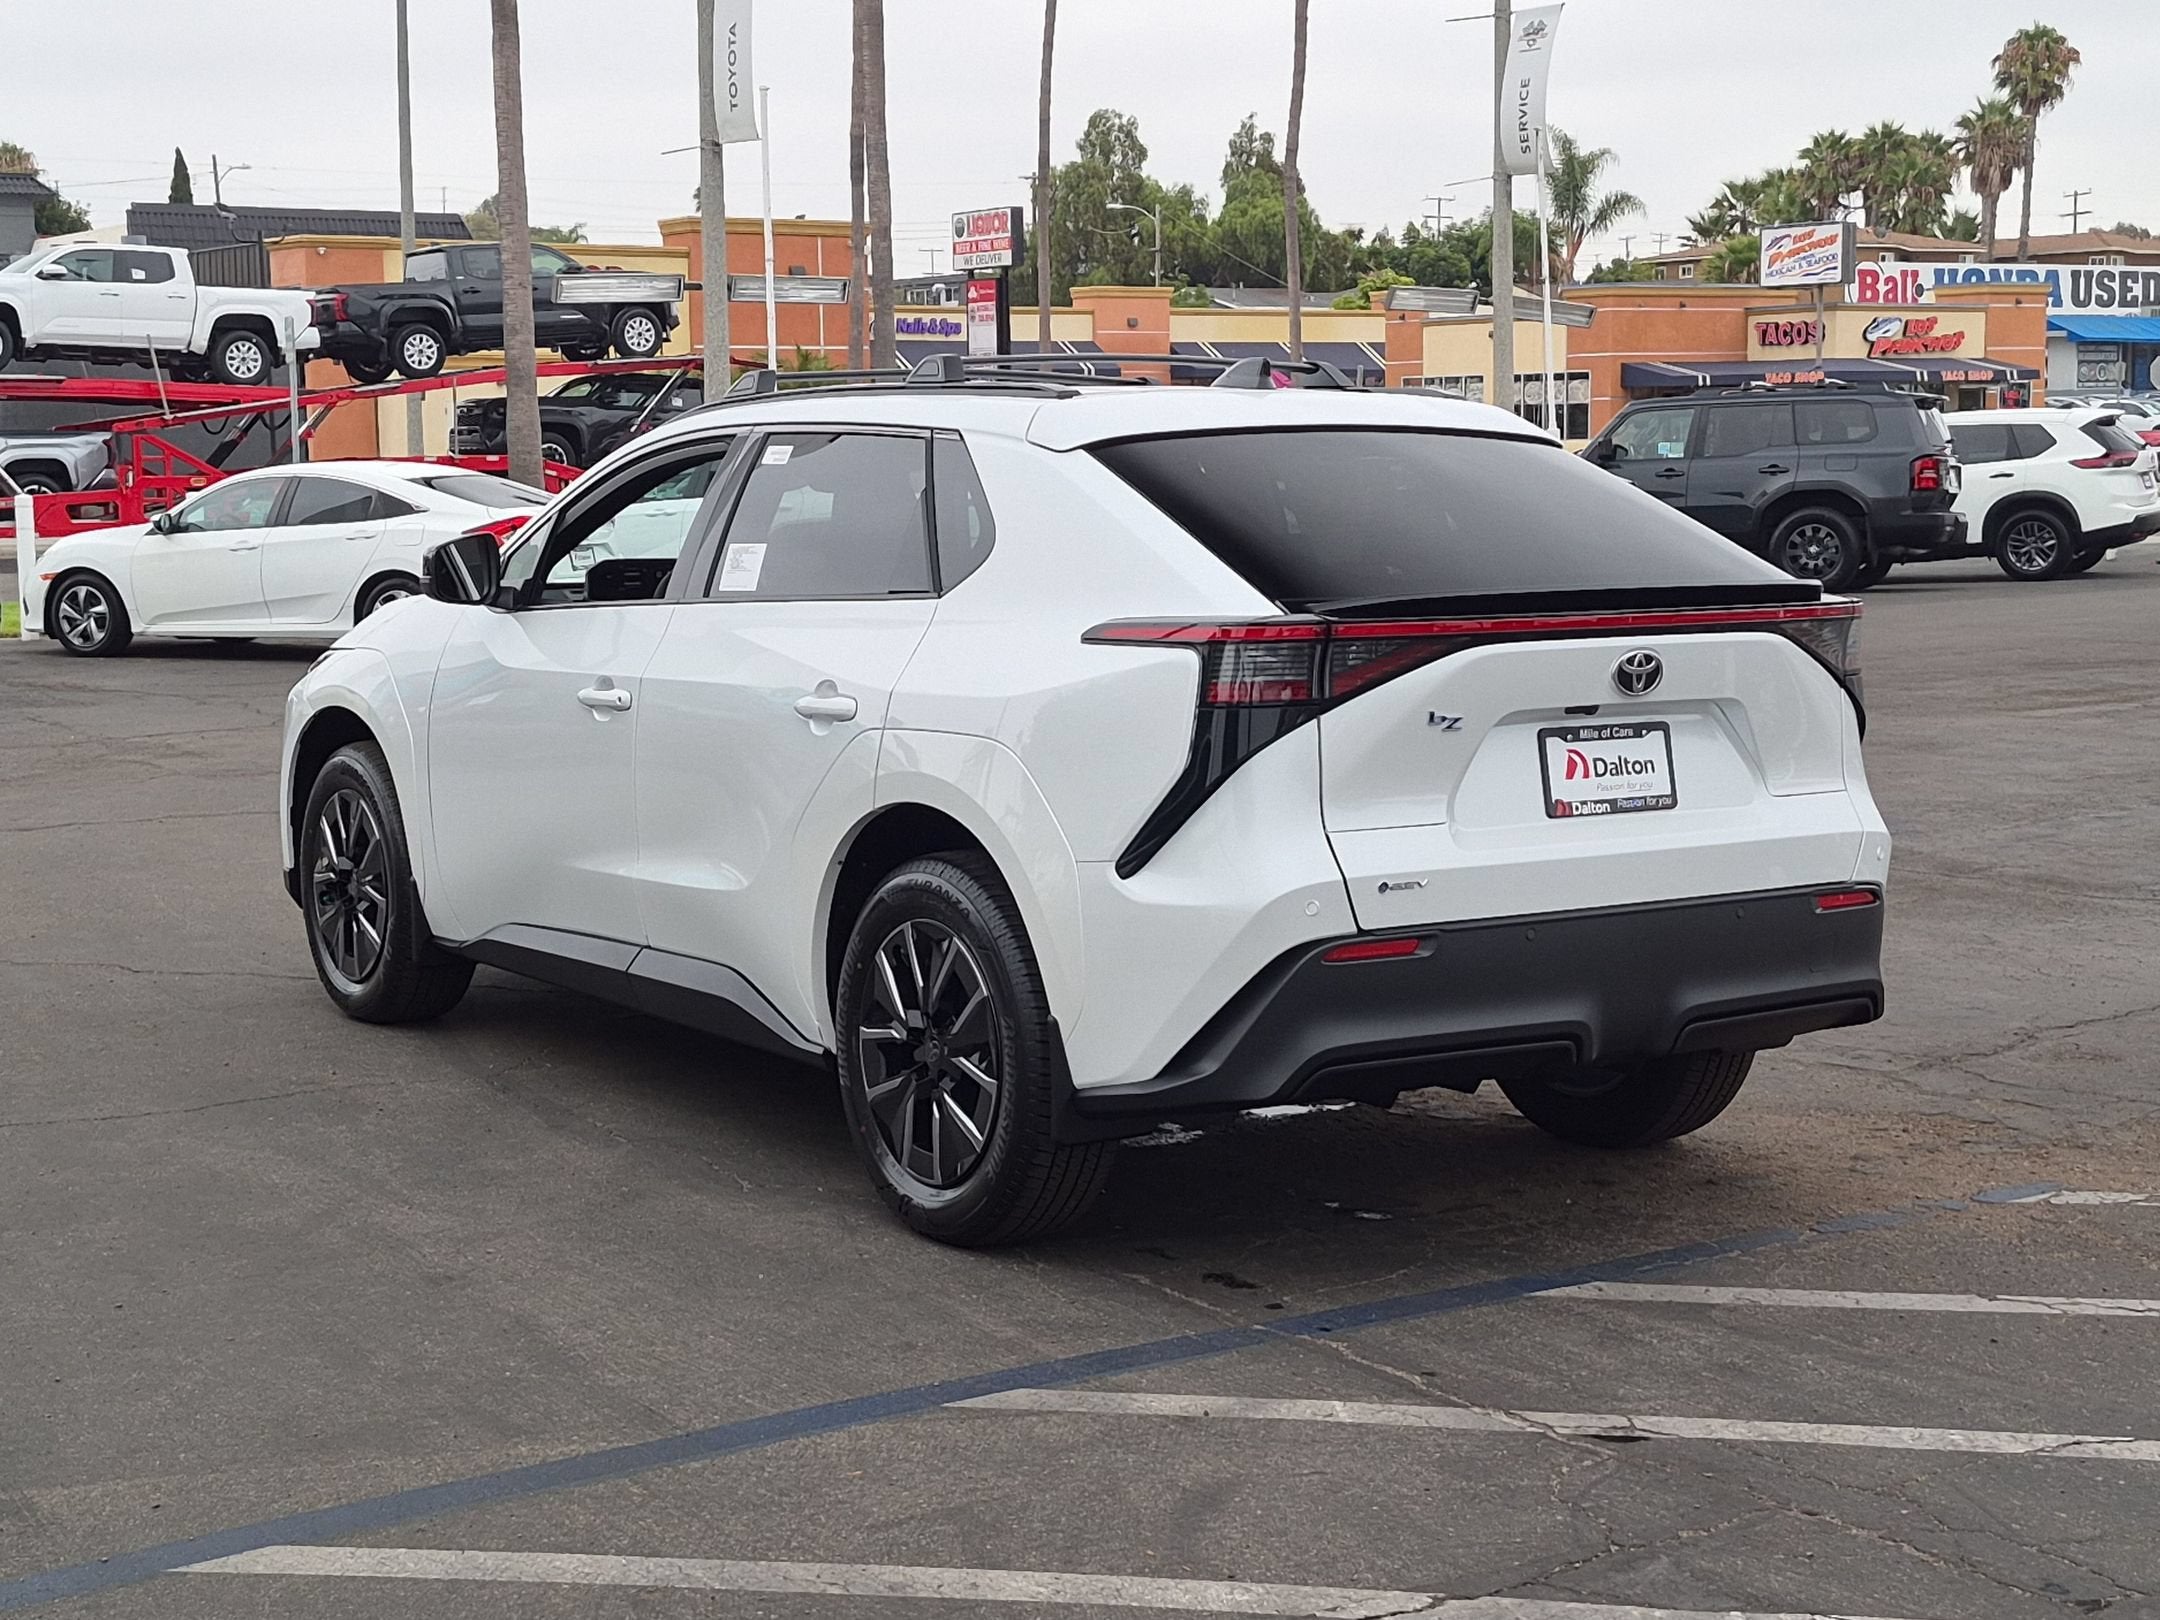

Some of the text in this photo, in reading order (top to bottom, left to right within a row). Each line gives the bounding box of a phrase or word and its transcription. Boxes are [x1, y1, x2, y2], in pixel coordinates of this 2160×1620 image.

[727, 22, 738, 113] TOYOTA
[1518, 77, 1531, 154] SERVICE
[967, 210, 1009, 237] LIQUOR
[1792, 228, 1816, 245] LOS
[963, 252, 1002, 266] WE DELIVER
[1767, 233, 1839, 270] PANCHOS
[1765, 264, 1796, 278] MEXICAN
[1804, 252, 1839, 268] SEAFOOD
[1856, 268, 1920, 304] Ball
[2070, 269, 2160, 309] USED
[896, 317, 928, 335] Nails
[928, 318, 938, 335] &
[938, 317, 962, 338] Spa
[1754, 320, 1825, 347] TACOS
[1904, 316, 1938, 337] LOS
[1870, 330, 1965, 358] PANCHOS
[1764, 371, 1825, 385] TACO SHOP
[1940, 370, 1994, 381] TACO SHOP
[1579, 727, 1634, 739] Mile of Cars
[1592, 754, 1656, 778] Dalton
[1596, 781, 1654, 792] Passion for you
[1572, 796, 1672, 816] Dalton Passion for you
[907, 878, 970, 919] TURANZA
[985, 1015, 1016, 1185] BRIDGESTONE
